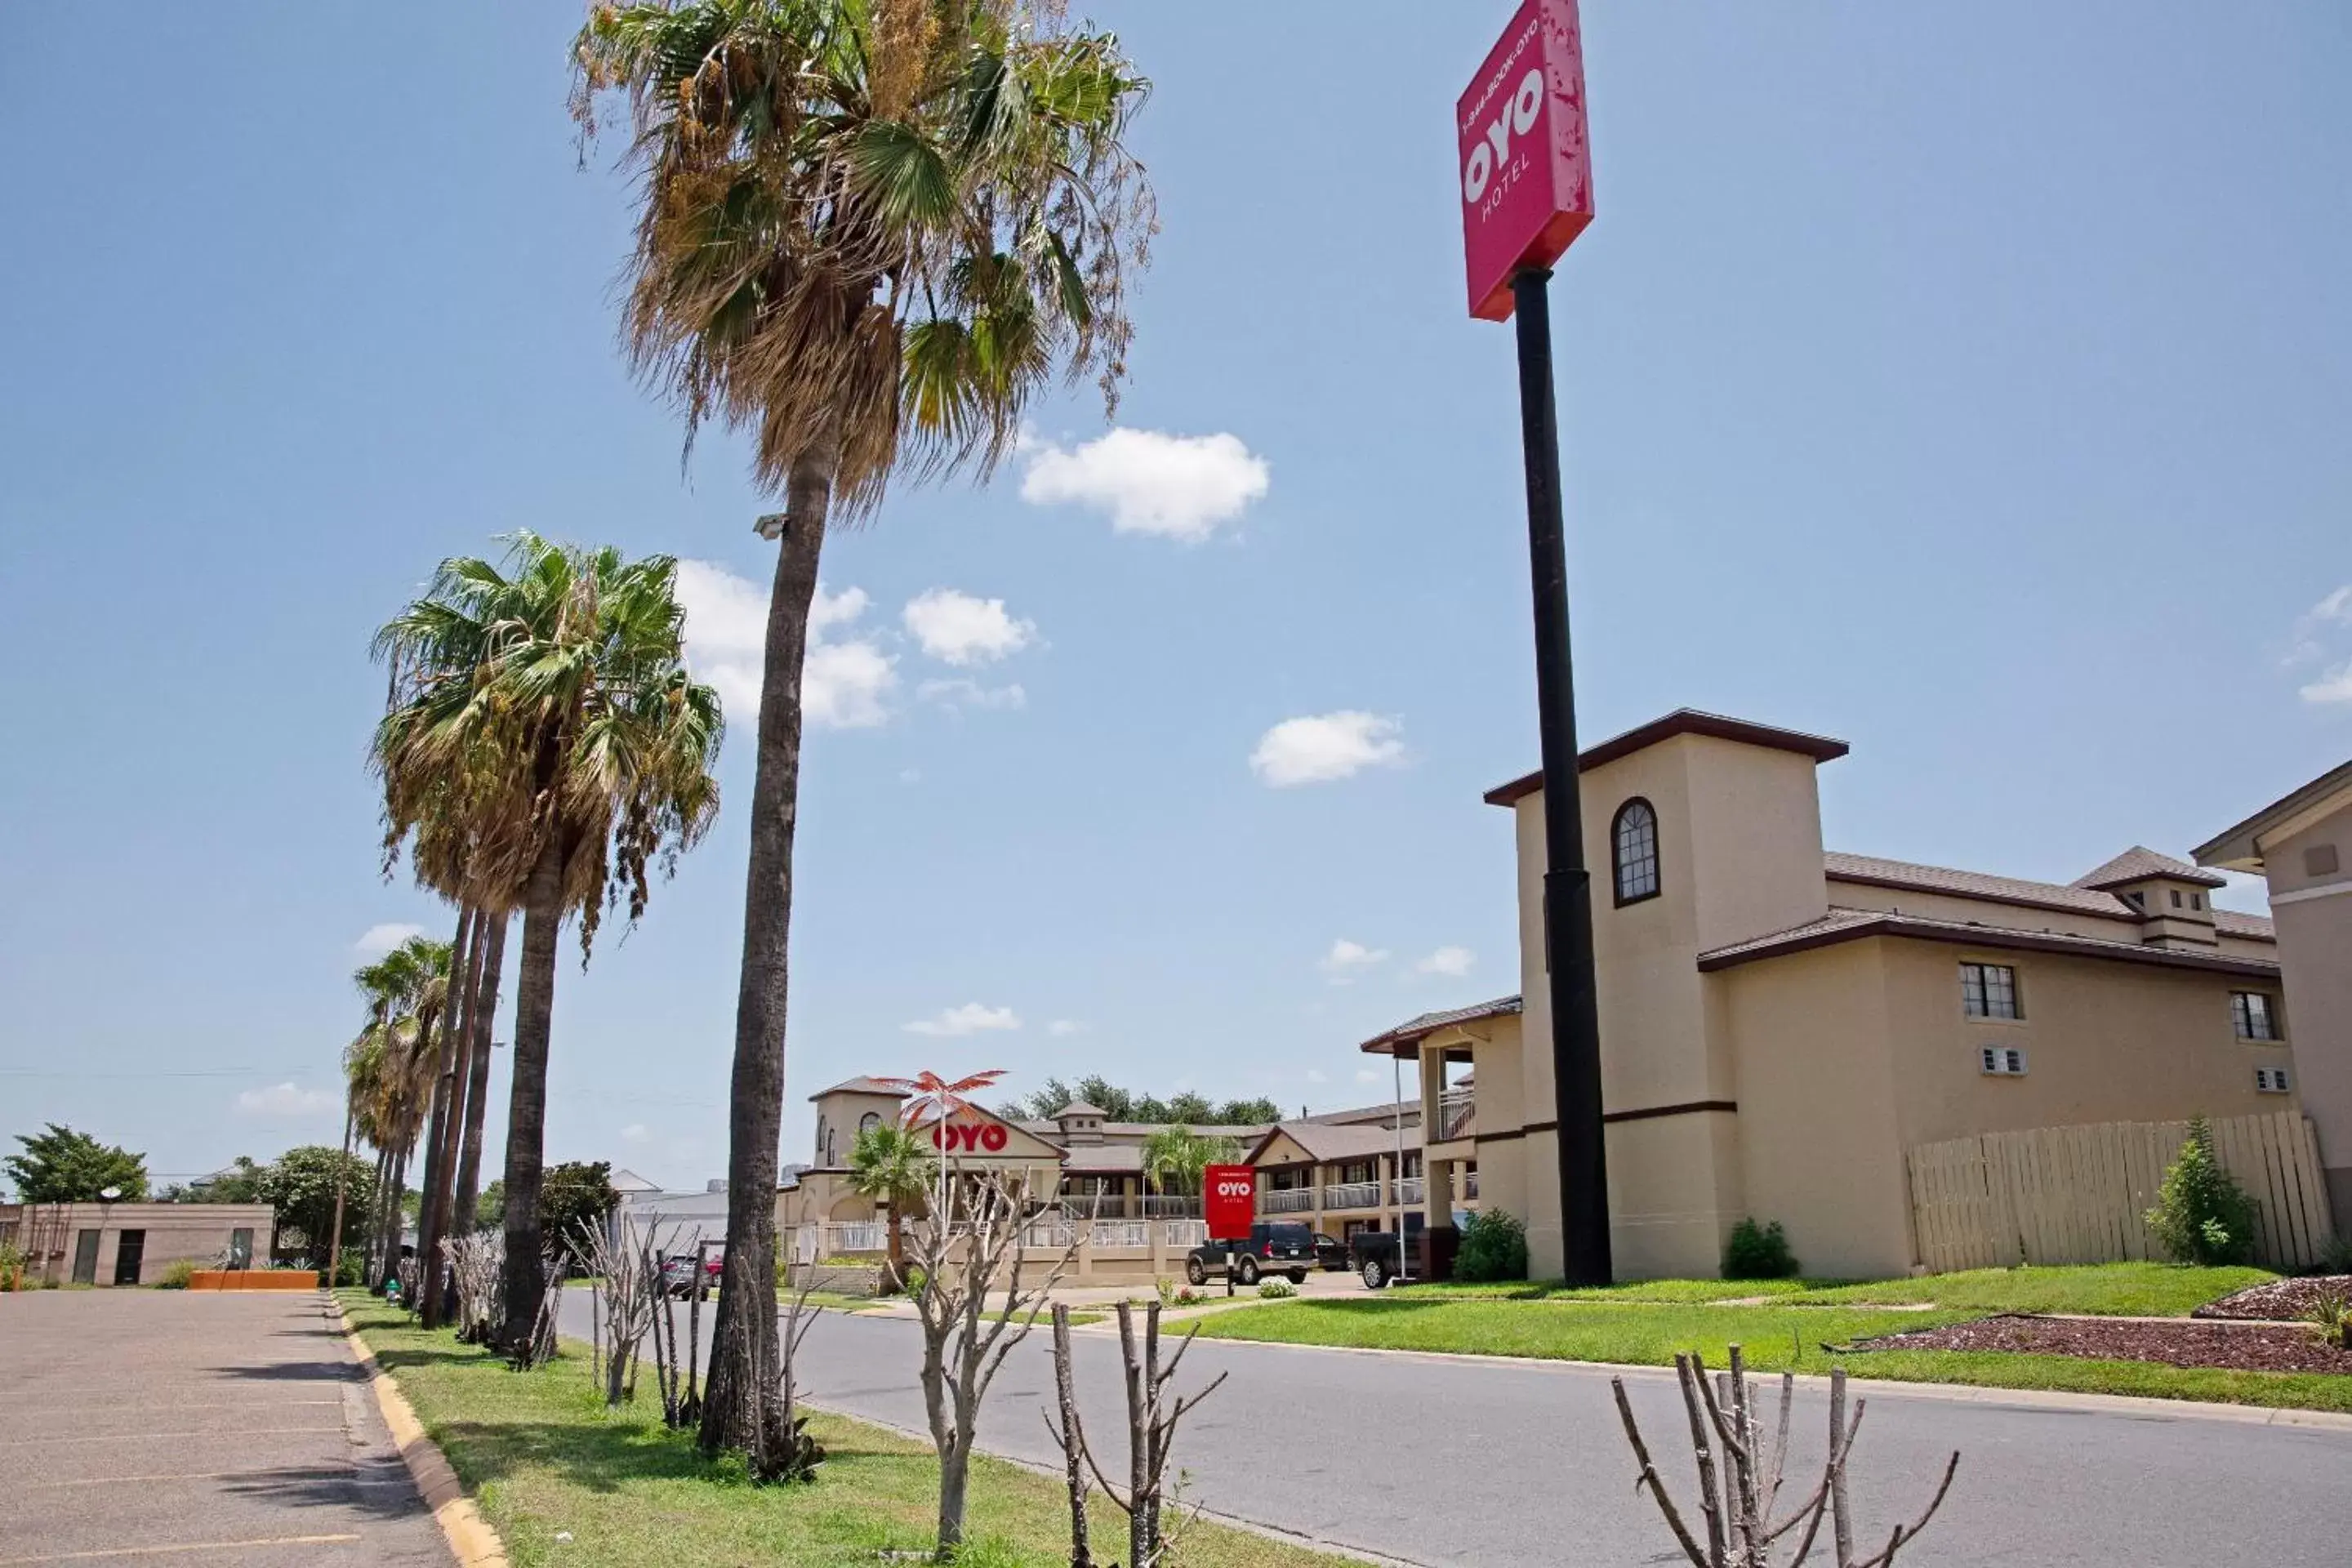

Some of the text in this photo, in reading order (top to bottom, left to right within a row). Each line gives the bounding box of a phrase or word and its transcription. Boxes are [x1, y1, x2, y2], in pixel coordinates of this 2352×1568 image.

[1464, 68, 1544, 203] OYO
[1481, 152, 1530, 223] HOTEL
[933, 1124, 1008, 1152] OYO
[1218, 1182, 1250, 1196] OYO
